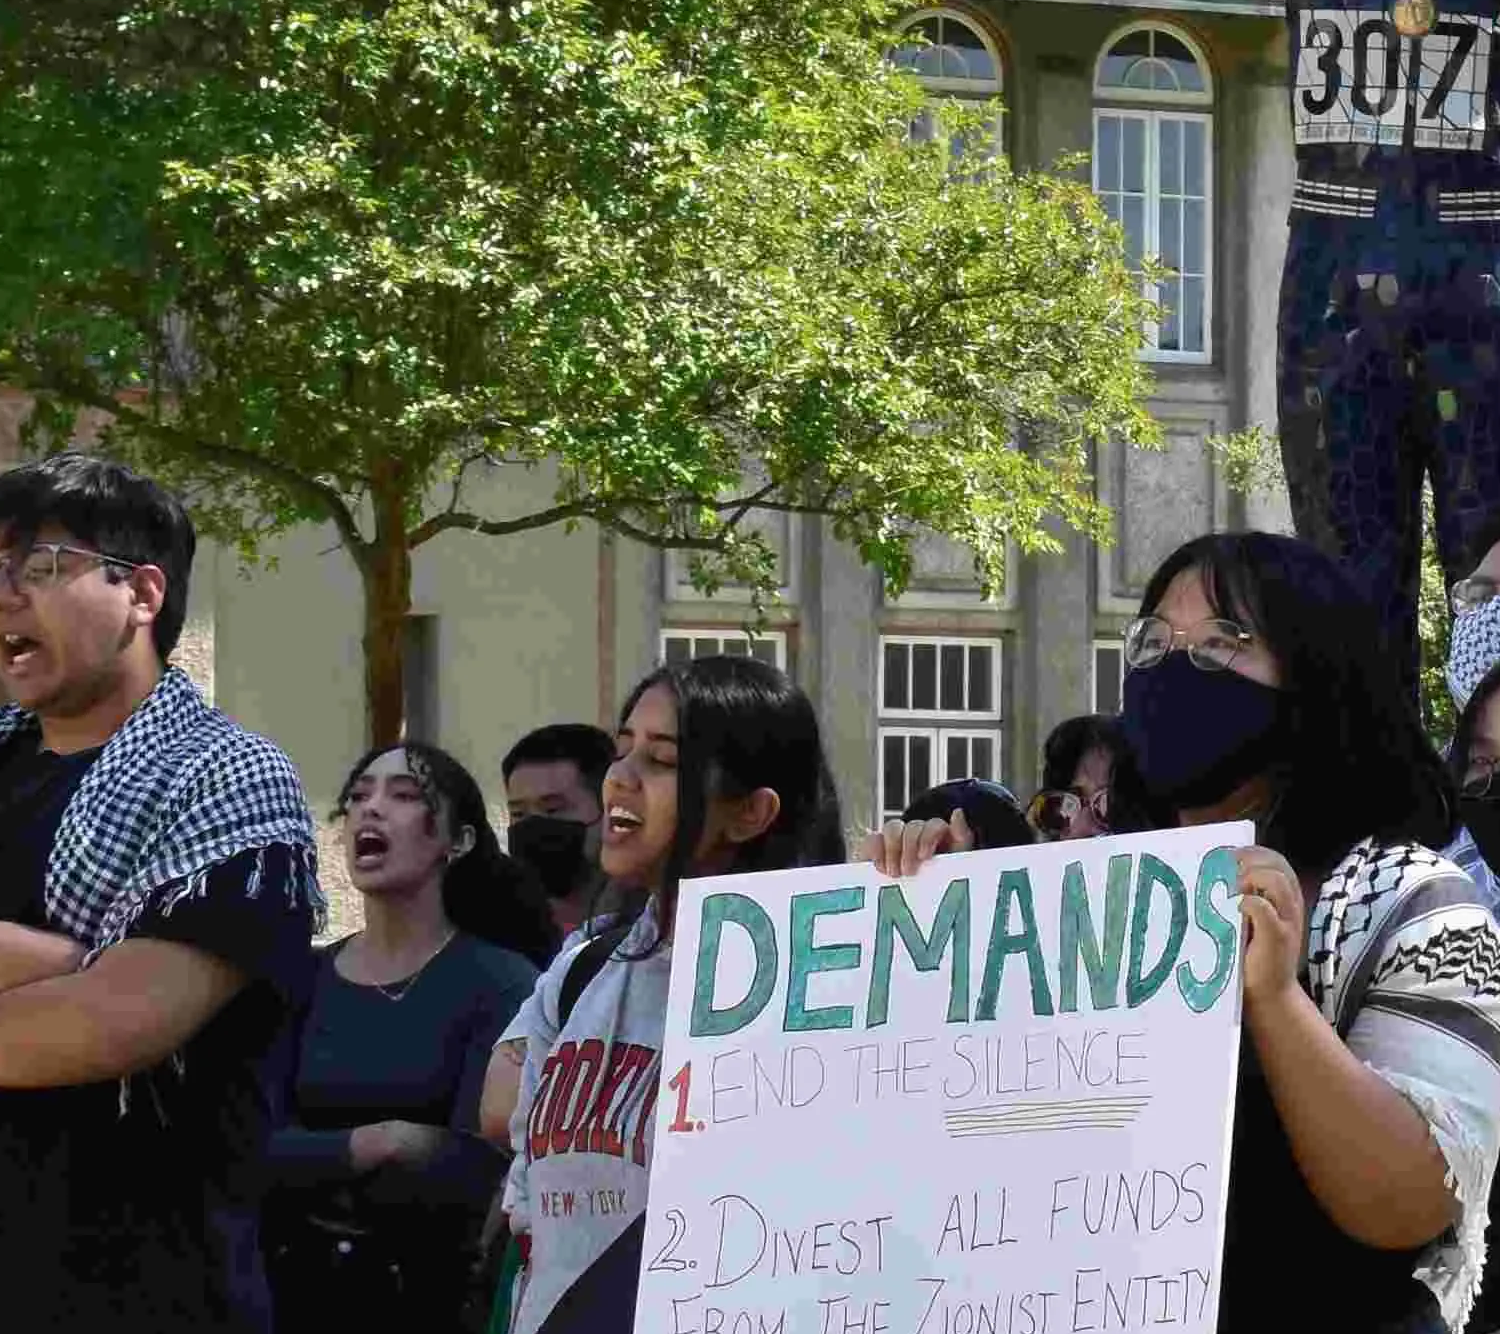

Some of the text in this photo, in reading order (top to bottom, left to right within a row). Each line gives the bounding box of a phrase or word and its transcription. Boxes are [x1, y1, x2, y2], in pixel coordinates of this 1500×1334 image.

[1298, 15, 1482, 123] 307
[689, 845, 1242, 1037] DEMANDS
[668, 1031, 1149, 1132] 1. END THE SILENCE
[541, 1188, 628, 1216] NEW YORK
[647, 1209, 699, 1272] 2.
[936, 1187, 1019, 1257] ALL
[1049, 1162, 1208, 1241] FUNDS
